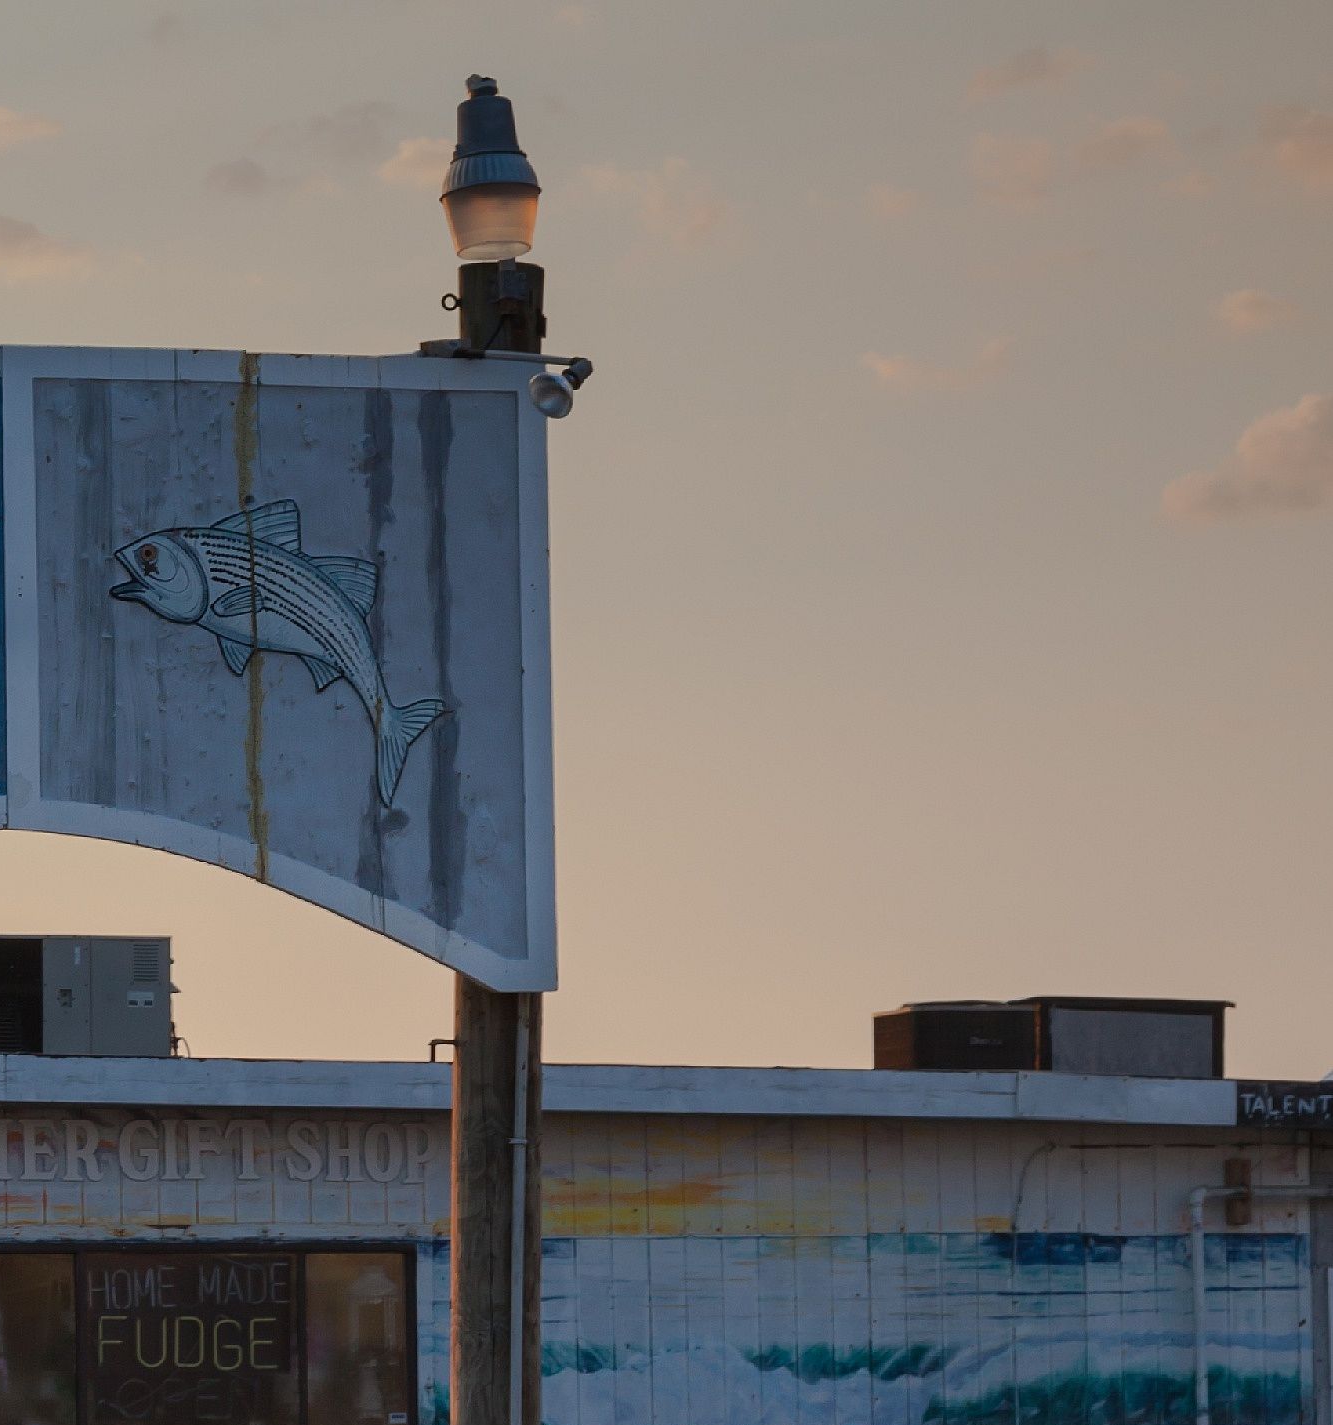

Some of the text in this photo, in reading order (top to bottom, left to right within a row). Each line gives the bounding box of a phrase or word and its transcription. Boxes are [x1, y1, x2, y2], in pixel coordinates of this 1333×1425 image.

[119, 1117, 271, 1183] GIFT
[285, 1118, 434, 1184] SHOP
[87, 1261, 290, 1310] HOME MADE
[96, 1314, 280, 1372] FUDGE
